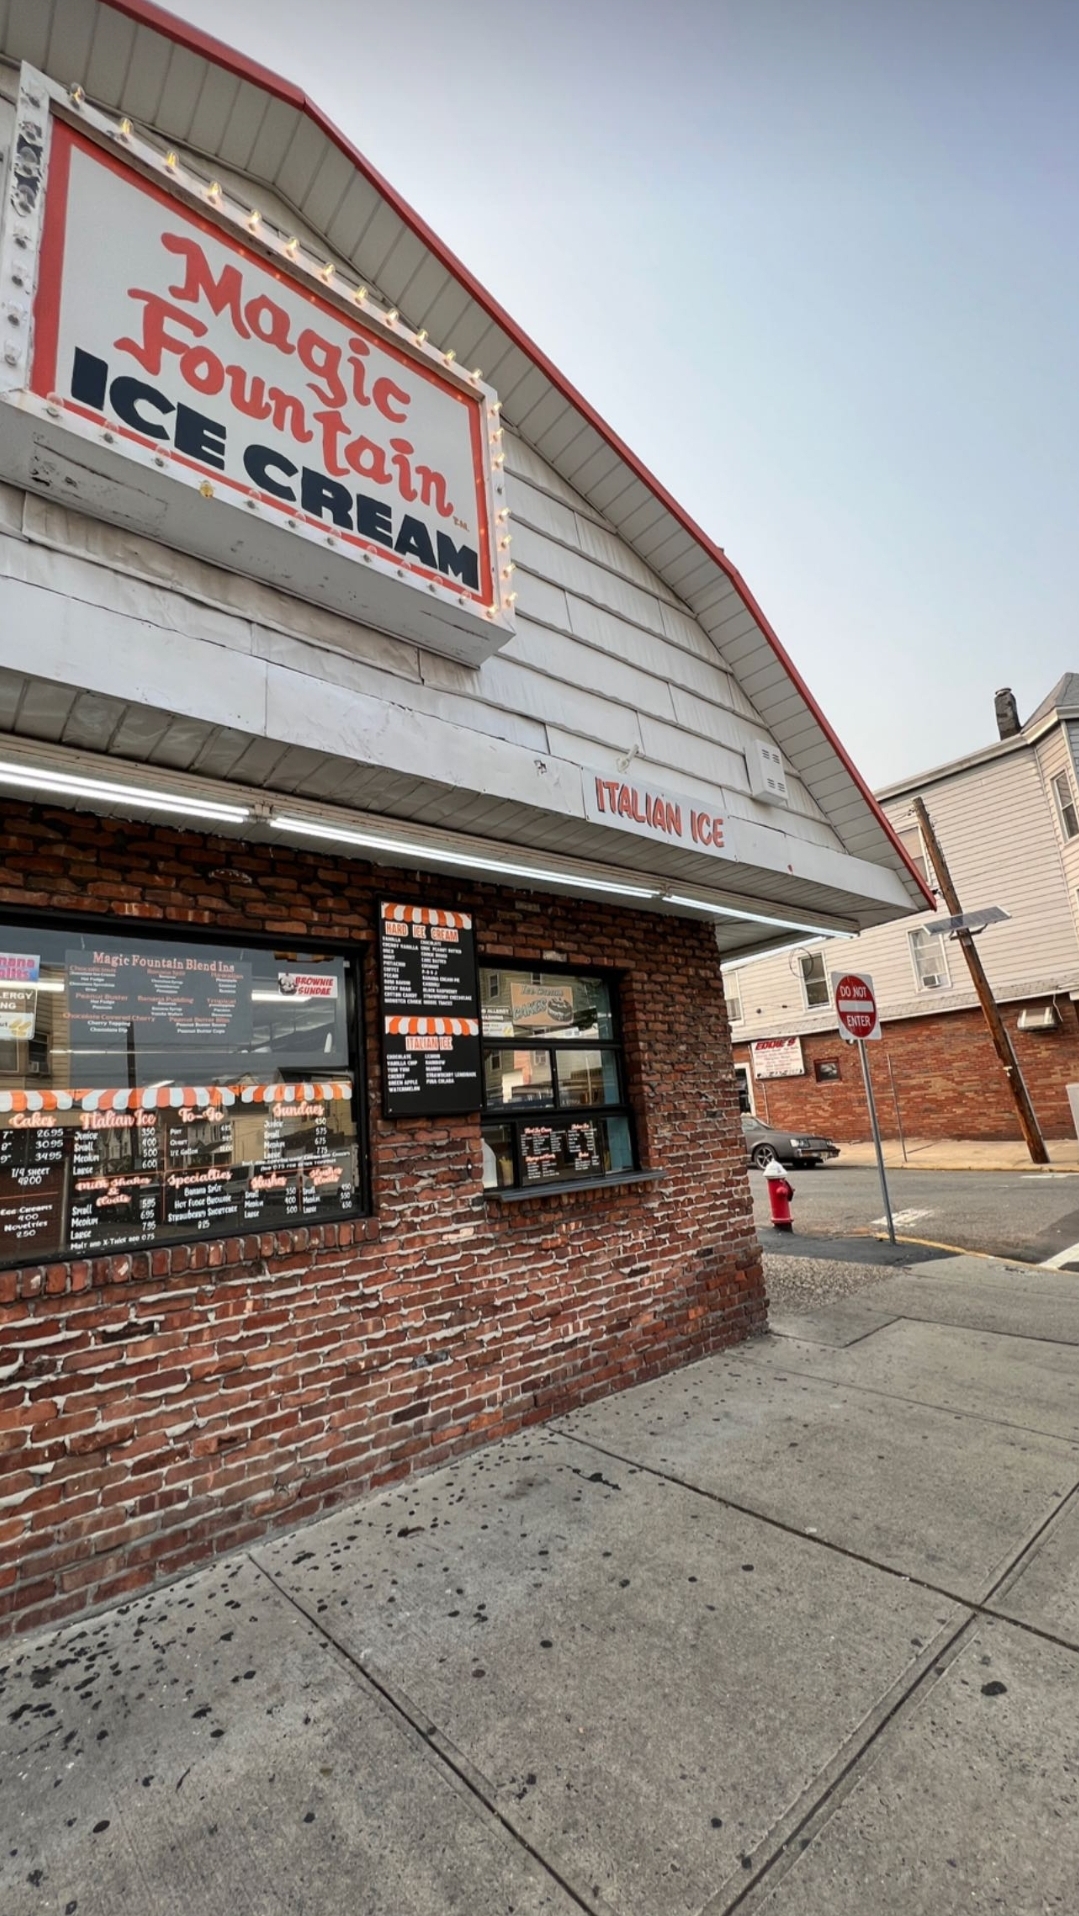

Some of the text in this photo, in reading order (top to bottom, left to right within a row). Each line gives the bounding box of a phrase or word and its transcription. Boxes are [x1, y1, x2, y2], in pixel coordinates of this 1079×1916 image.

[161, 232, 411, 423] Magic
[113, 288, 453, 518] Fountain
[71, 346, 479, 590] ICE CREAM
[595, 776, 725, 848] ITALIAN ICE
[385, 921, 459, 943] HARD ICE CREAM
[93, 951, 130, 967] Magic
[132, 955, 184, 970] Fountain
[186, 959, 217, 972] Blend
[218, 961, 235, 973] Ins
[295, 976, 334, 987] BROWNIE
[297, 986, 332, 996] SUNDAE
[840, 986, 867, 998] DO NOT
[513, 998, 547, 1021] CAKES
[847, 1015, 871, 1027] ENTER
[405, 1036, 453, 1051] ITALIAN ICE
[178, 1106, 224, 1123] To-Go
[272, 1100, 325, 1117] Sundaes
[9, 1111, 57, 1128] Cakes
[79, 1109, 156, 1130] Italian Ice
[37, 1129, 64, 1138] 26.95
[74, 1131, 99, 1141] Junior
[35, 1140, 64, 1149] 30.95
[74, 1141, 94, 1152] Small
[35, 1152, 63, 1161] 34.95
[73, 1166, 94, 1176] Large
[167, 1168, 234, 1190] Specialties
[72, 1203, 92, 1216] Small
[70, 1230, 92, 1240] Large
